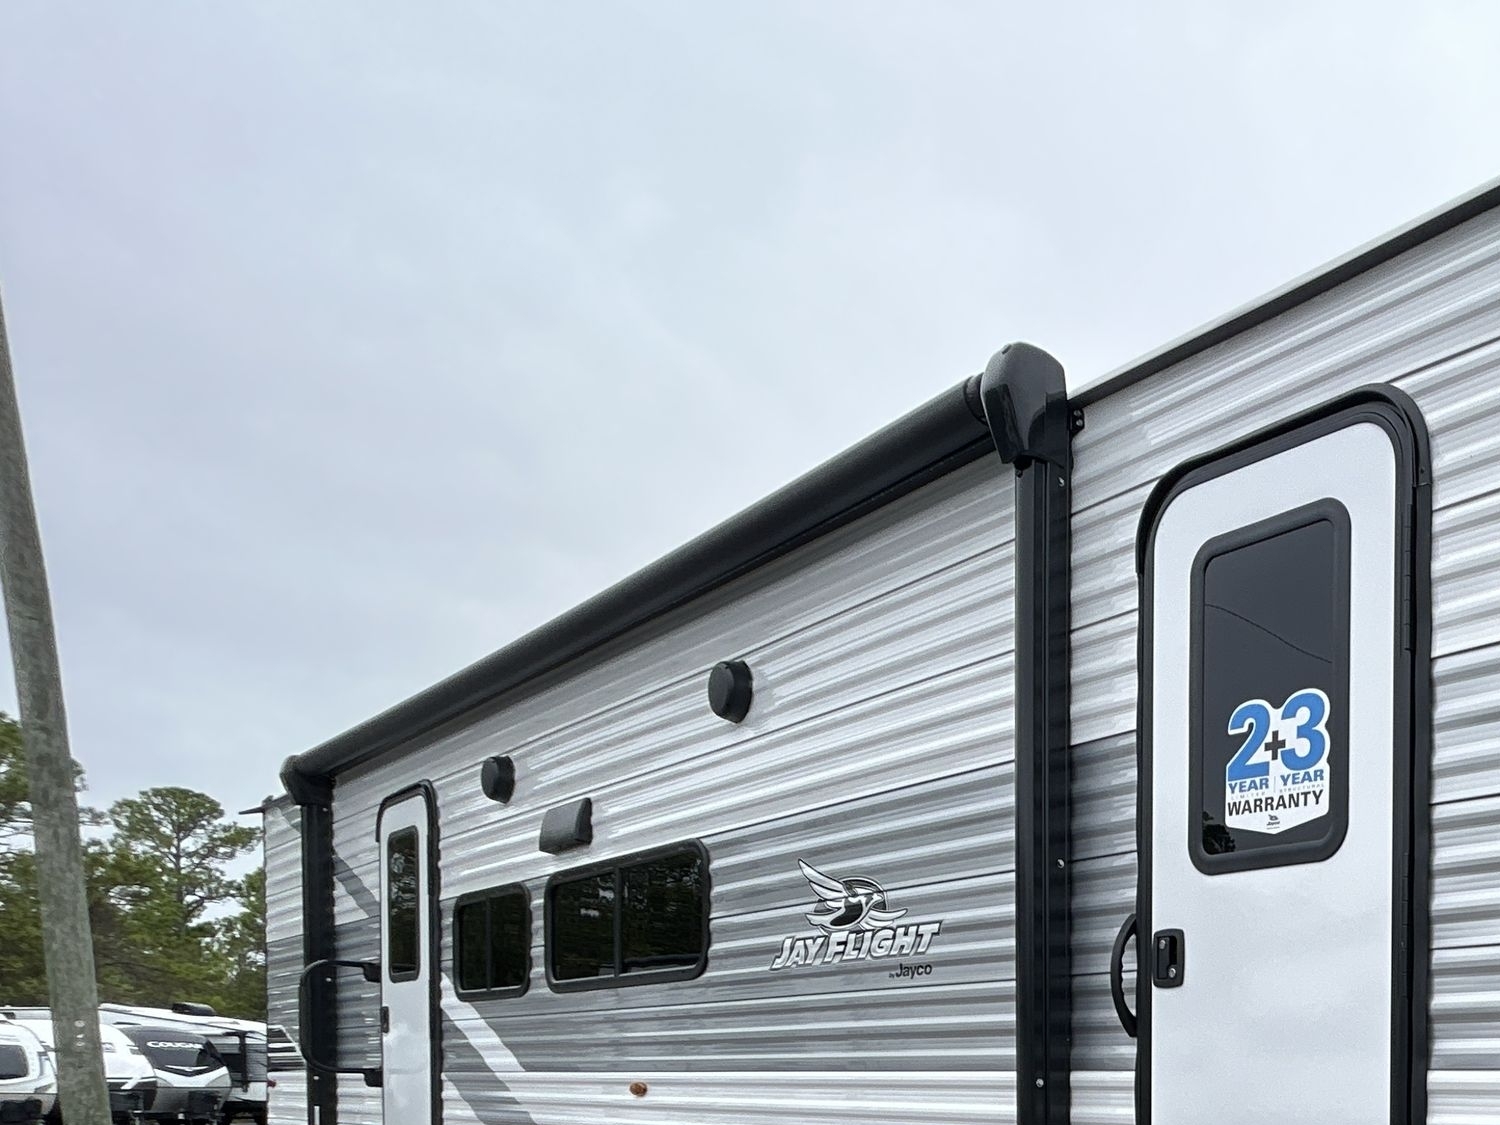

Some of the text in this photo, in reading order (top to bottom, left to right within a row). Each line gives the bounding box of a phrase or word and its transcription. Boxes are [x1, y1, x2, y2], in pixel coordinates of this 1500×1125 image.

[1228, 769, 1325, 795] YEAR YEAR
[1279, 783, 1325, 793] STRUCTURAL
[1227, 789, 1324, 817] WARRANTY
[769, 920, 943, 971] JAY FLIGHT
[895, 963, 932, 979] Jayco
